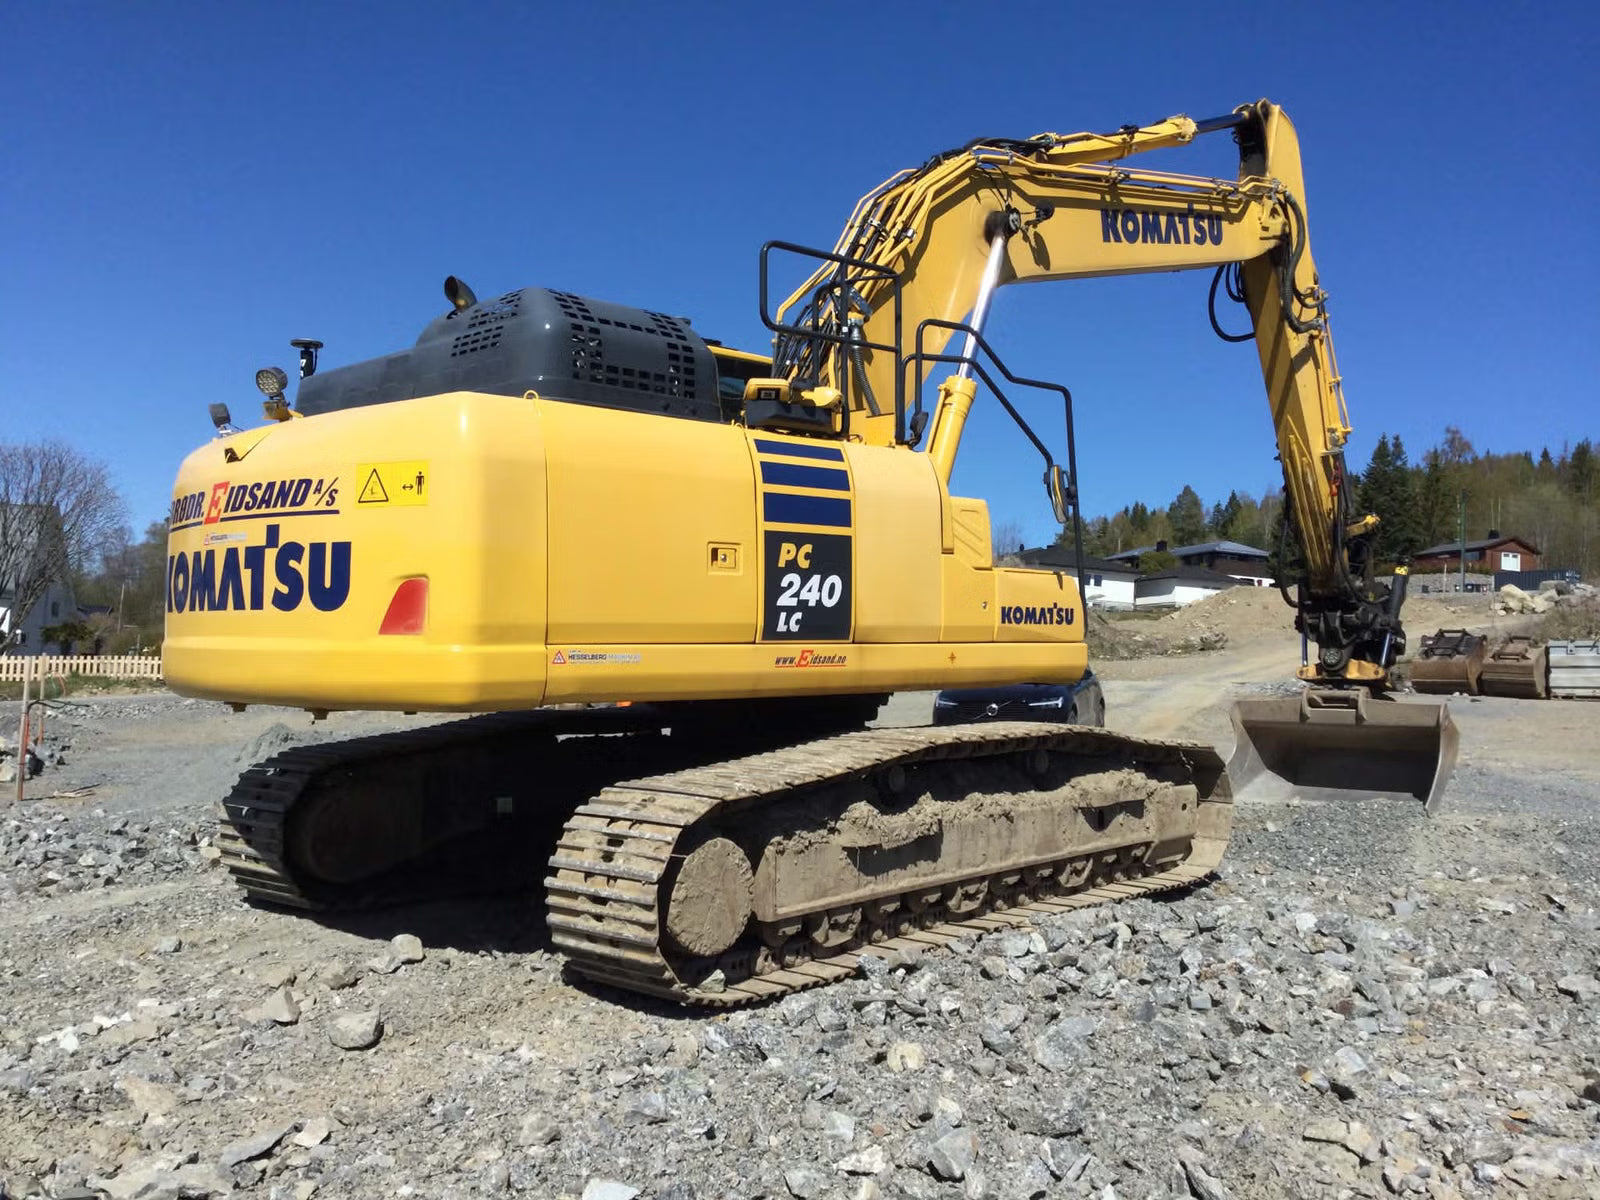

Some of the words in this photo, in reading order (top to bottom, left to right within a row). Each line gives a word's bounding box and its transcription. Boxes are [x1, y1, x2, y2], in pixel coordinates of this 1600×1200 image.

[1101, 203, 1223, 246] KOMATSU
[204, 478, 312, 524] EIDSAND
[313, 476, 339, 507] A/S
[777, 542, 813, 569] PC
[775, 572, 843, 608] 240
[775, 611, 802, 632] LC
[1001, 602, 1074, 626] KOMATSU
[775, 649, 847, 668] www.Eidsand.no
